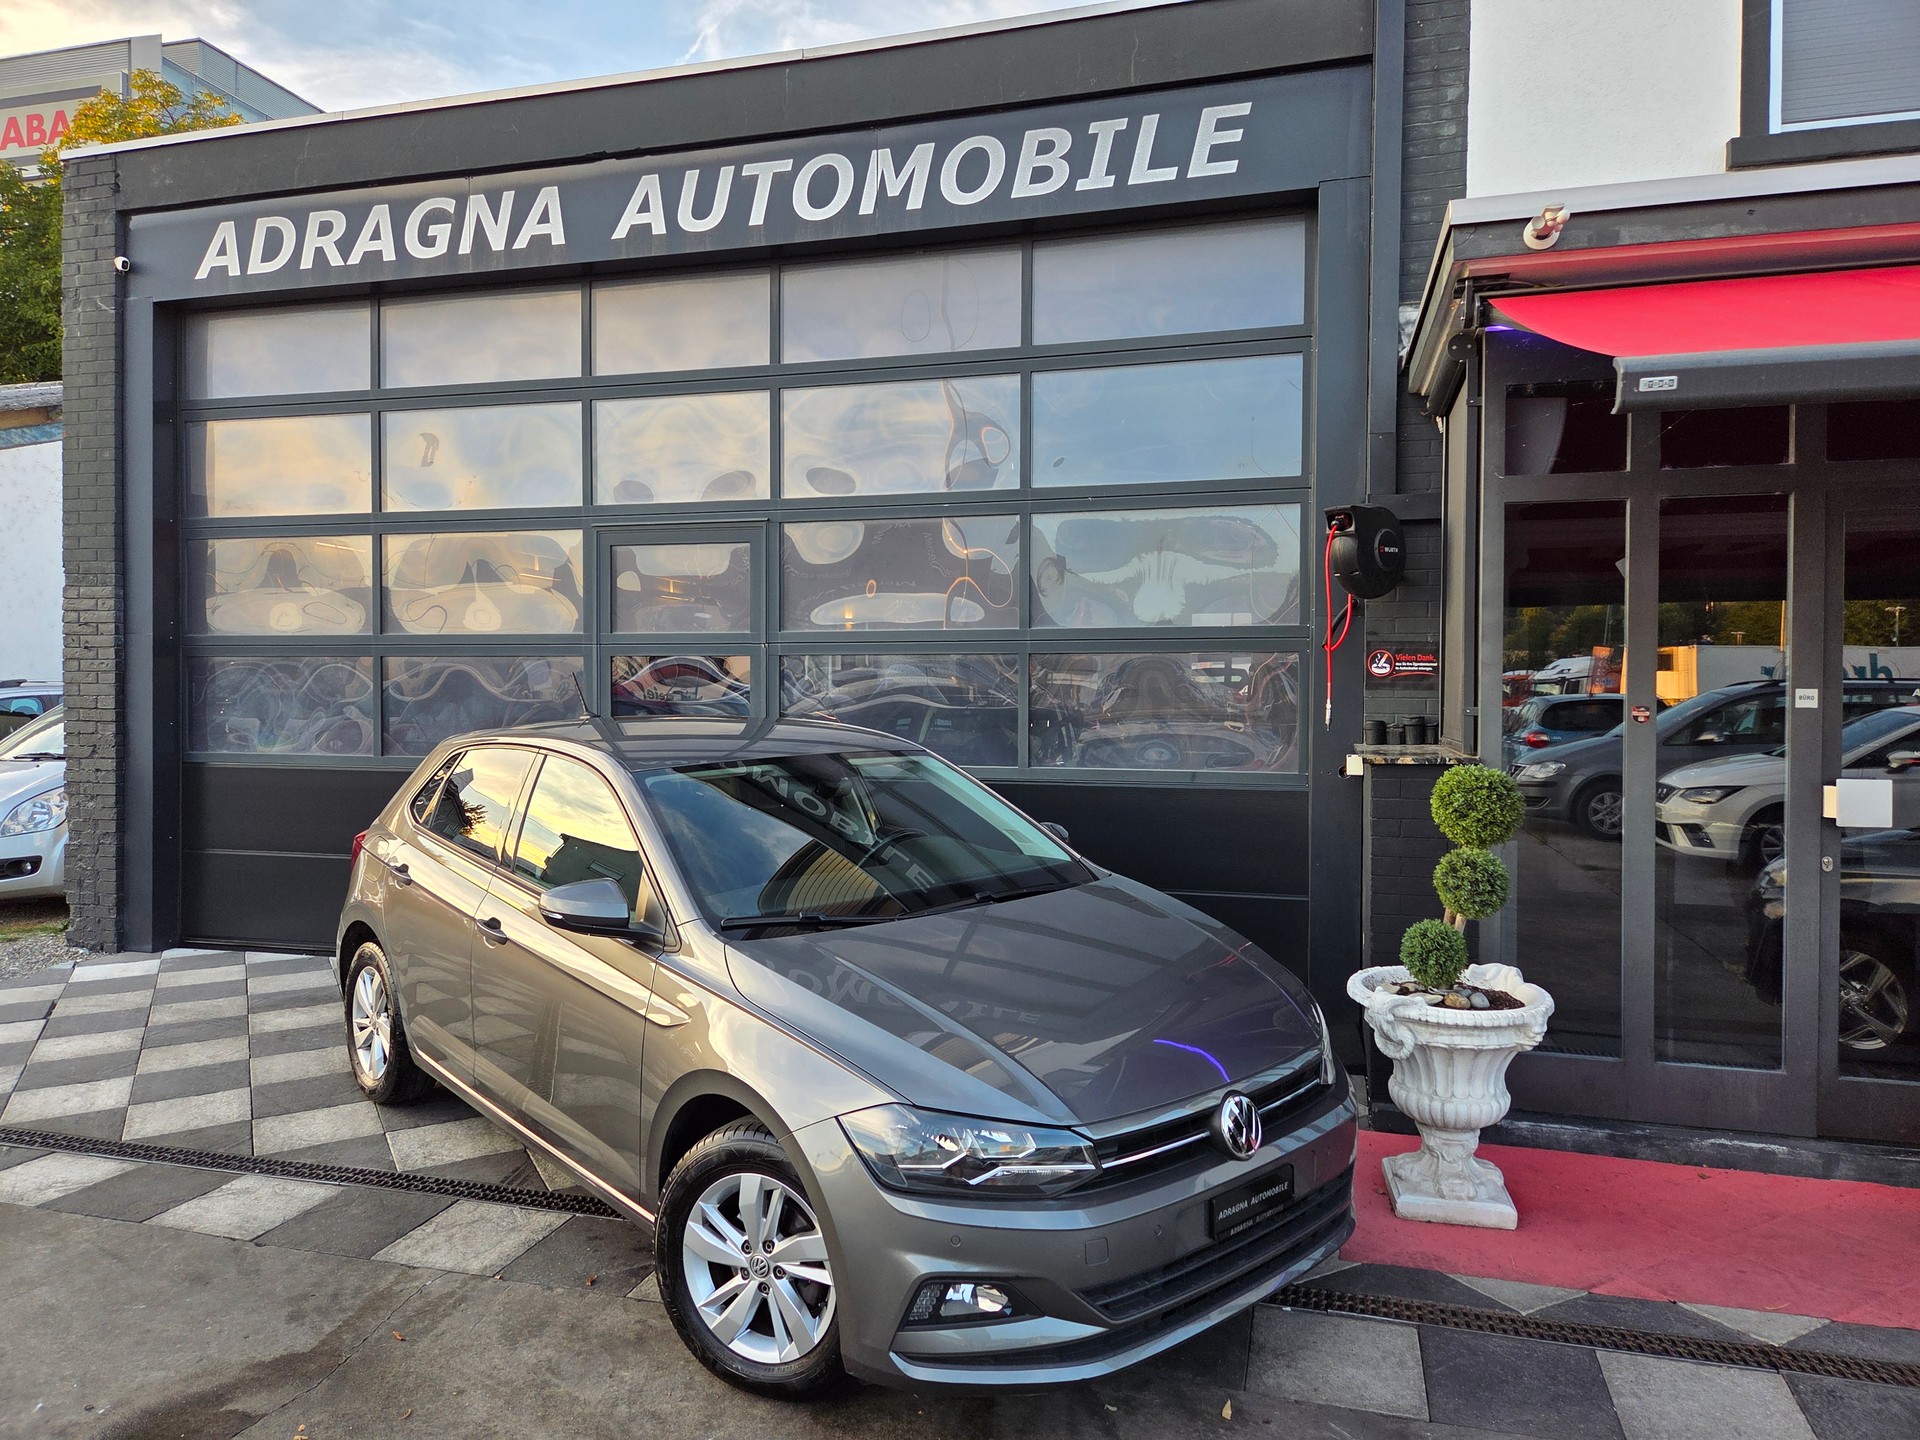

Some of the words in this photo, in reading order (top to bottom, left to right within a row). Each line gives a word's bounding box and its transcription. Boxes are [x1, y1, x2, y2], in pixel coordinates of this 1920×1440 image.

[195, 186, 565, 279] ADRAGNA
[611, 102, 1252, 239] AUTOMOBILE
[1395, 653, 1416, 661] Vielen
[1217, 1200, 1249, 1220] ADRAGNA
[1250, 1181, 1289, 1206] AUTOMOBILE
